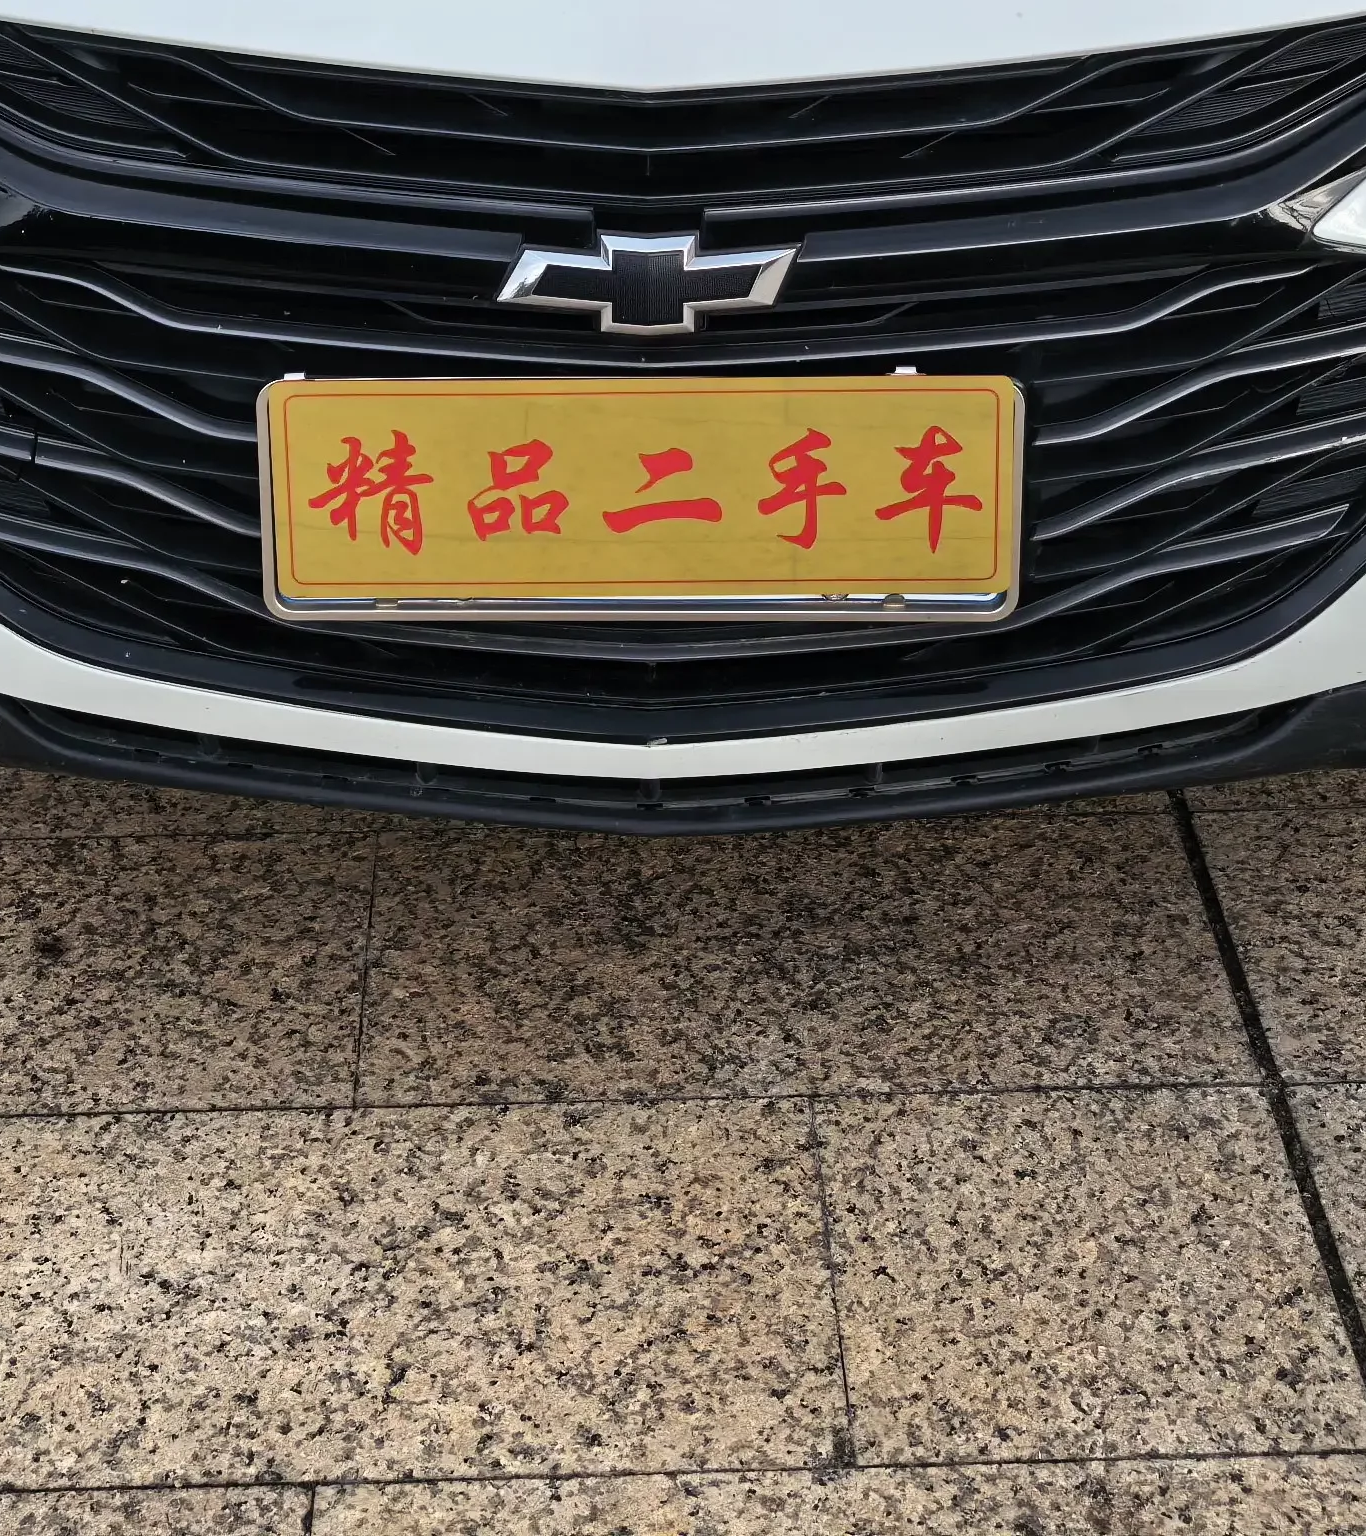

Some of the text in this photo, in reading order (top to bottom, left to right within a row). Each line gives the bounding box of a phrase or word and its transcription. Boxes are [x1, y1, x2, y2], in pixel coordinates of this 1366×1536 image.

[308, 426, 983, 556] 精品二手车
